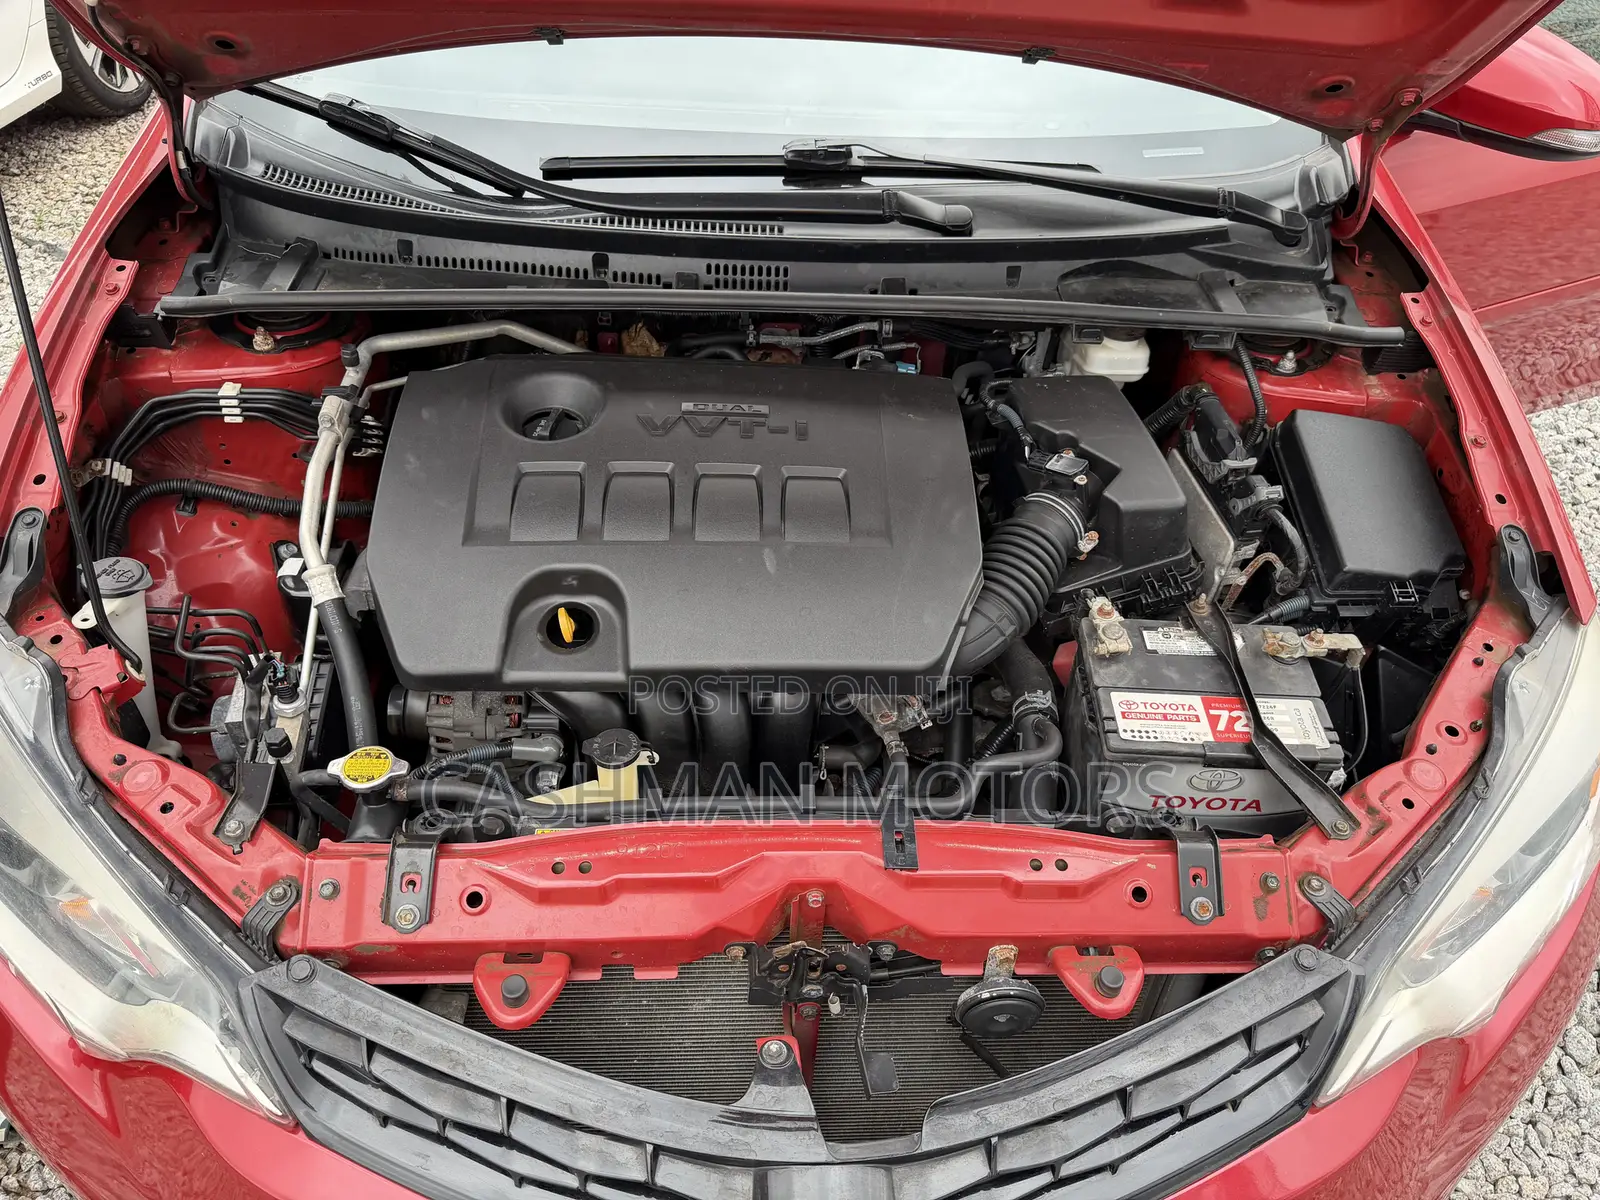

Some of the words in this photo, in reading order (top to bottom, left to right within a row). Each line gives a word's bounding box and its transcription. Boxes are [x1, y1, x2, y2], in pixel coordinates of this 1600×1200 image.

[692, 403, 762, 413] DUAL
[1140, 701, 1197, 713] TOYOTA
[1124, 711, 1165, 721] GENUINE
[1166, 713, 1197, 722] PARTS
[1208, 708, 1251, 733] 72
[1149, 794, 1262, 813] TOYOTA
